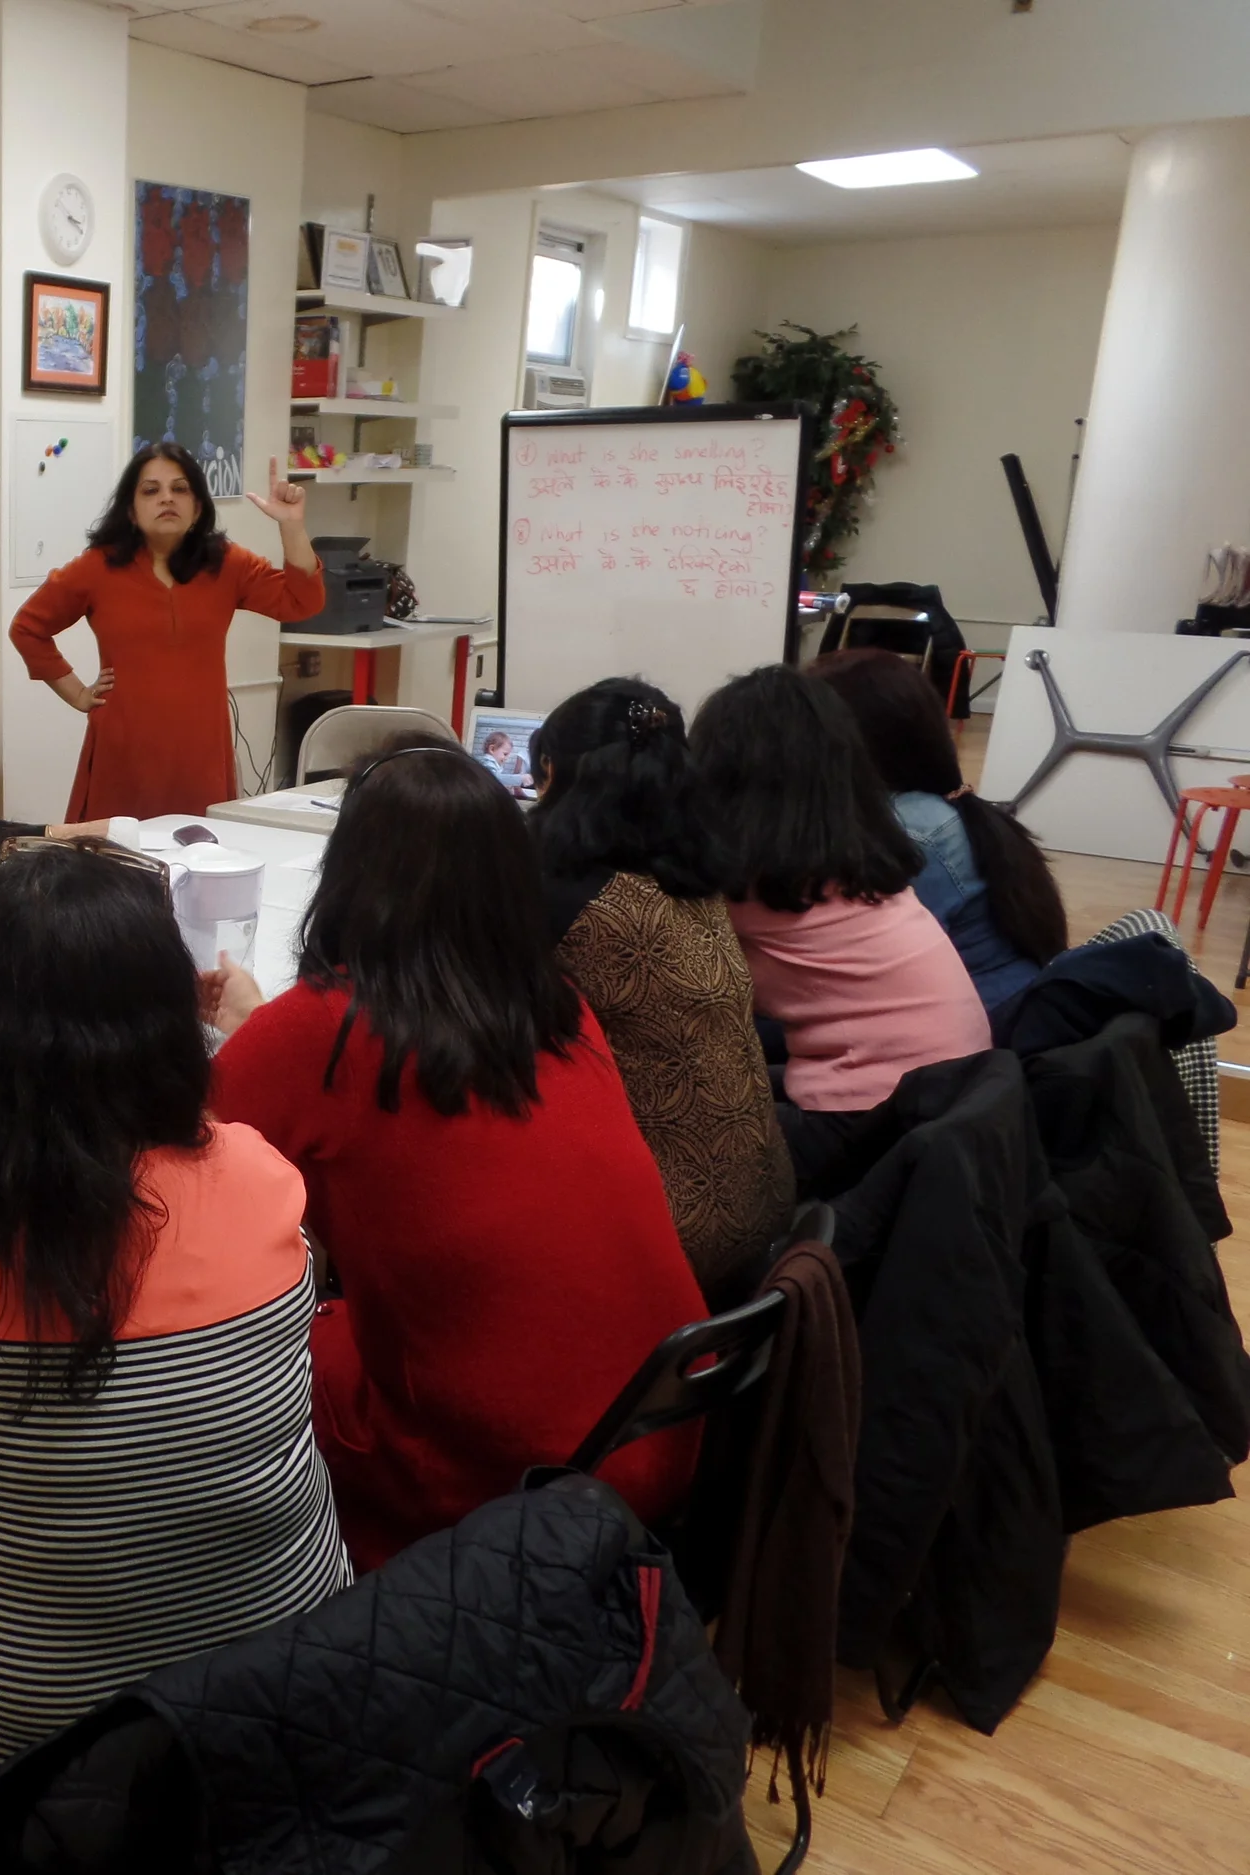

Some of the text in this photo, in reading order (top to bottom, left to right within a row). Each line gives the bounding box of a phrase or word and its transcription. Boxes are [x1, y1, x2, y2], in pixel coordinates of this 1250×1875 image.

[603, 449, 616, 462] is
[629, 441, 658, 462] she
[540, 519, 583, 543] What
[604, 529, 620, 542] is
[631, 516, 660, 538] she
